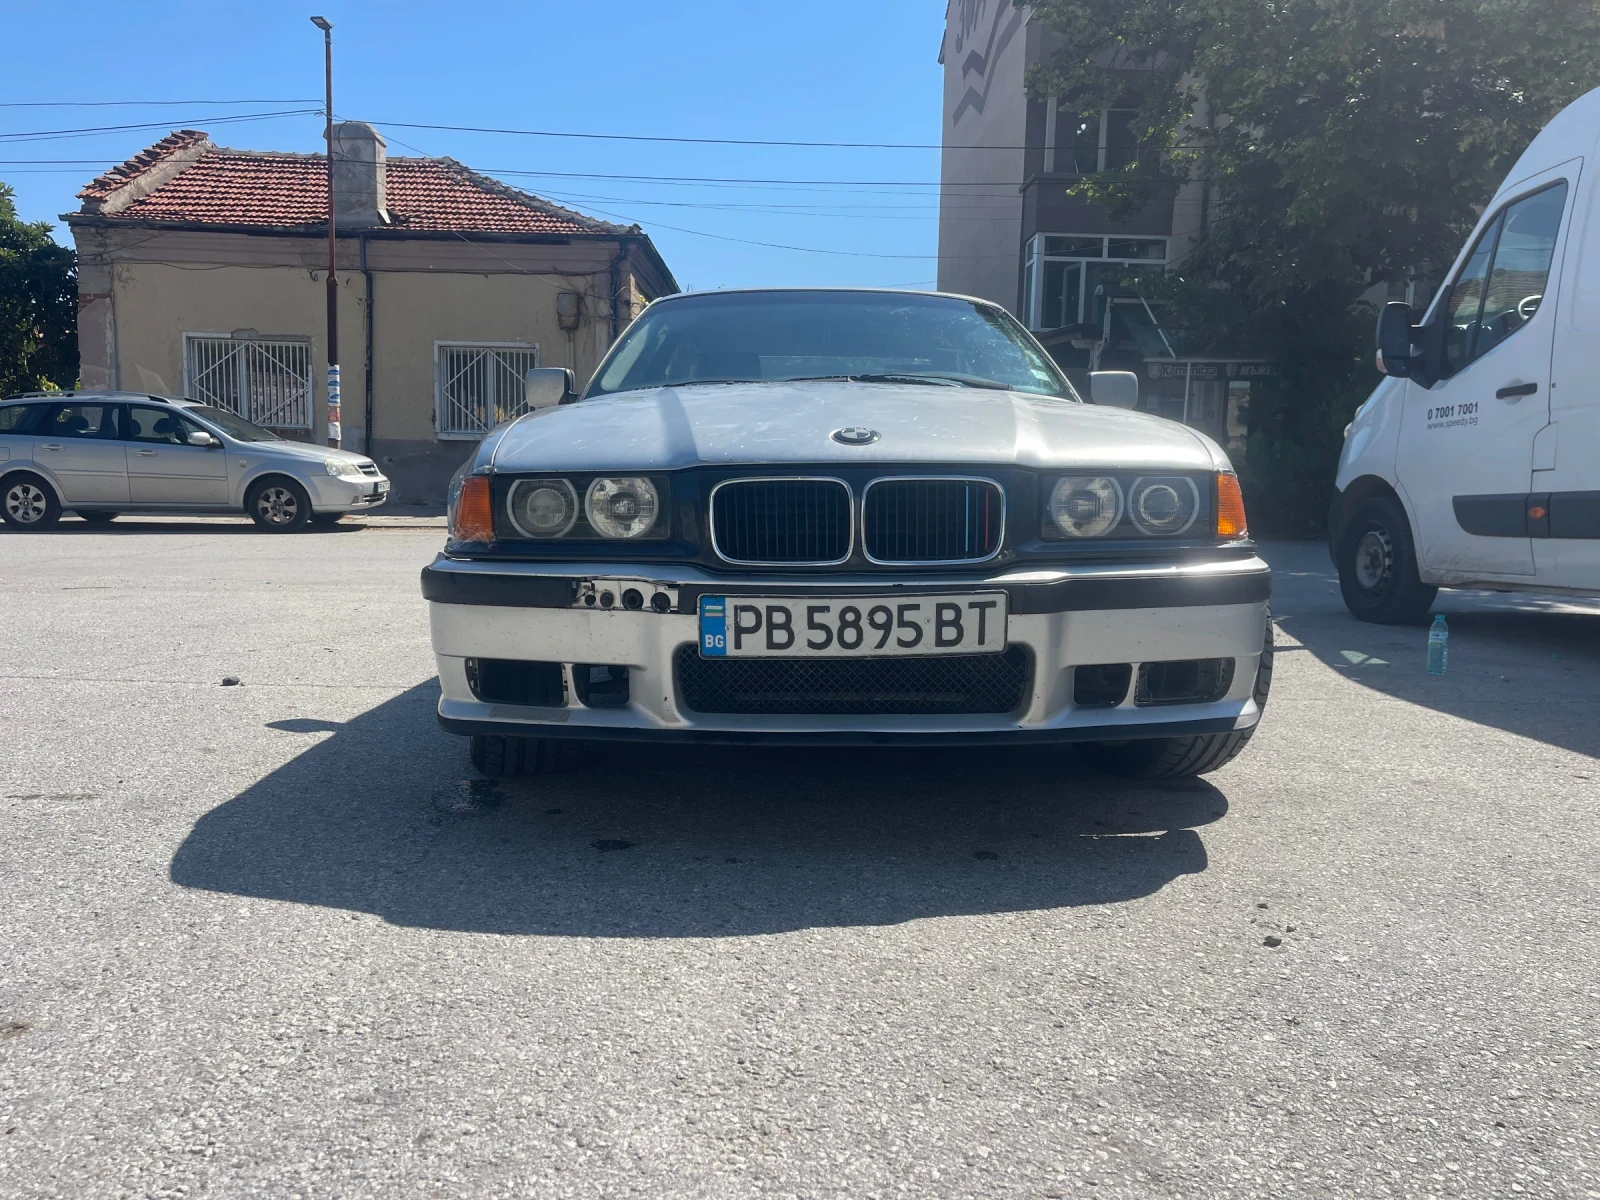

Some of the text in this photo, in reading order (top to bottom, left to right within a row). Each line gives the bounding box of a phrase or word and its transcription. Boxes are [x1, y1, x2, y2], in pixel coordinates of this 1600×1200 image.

[1162, 364, 1218, 377] Kamnitza
[1427, 402, 1479, 420] 0 7001 7001
[1427, 416, 1479, 430] www.speedy.bg
[733, 600, 998, 650] PB 5895 BT
[704, 634, 725, 649] BG
